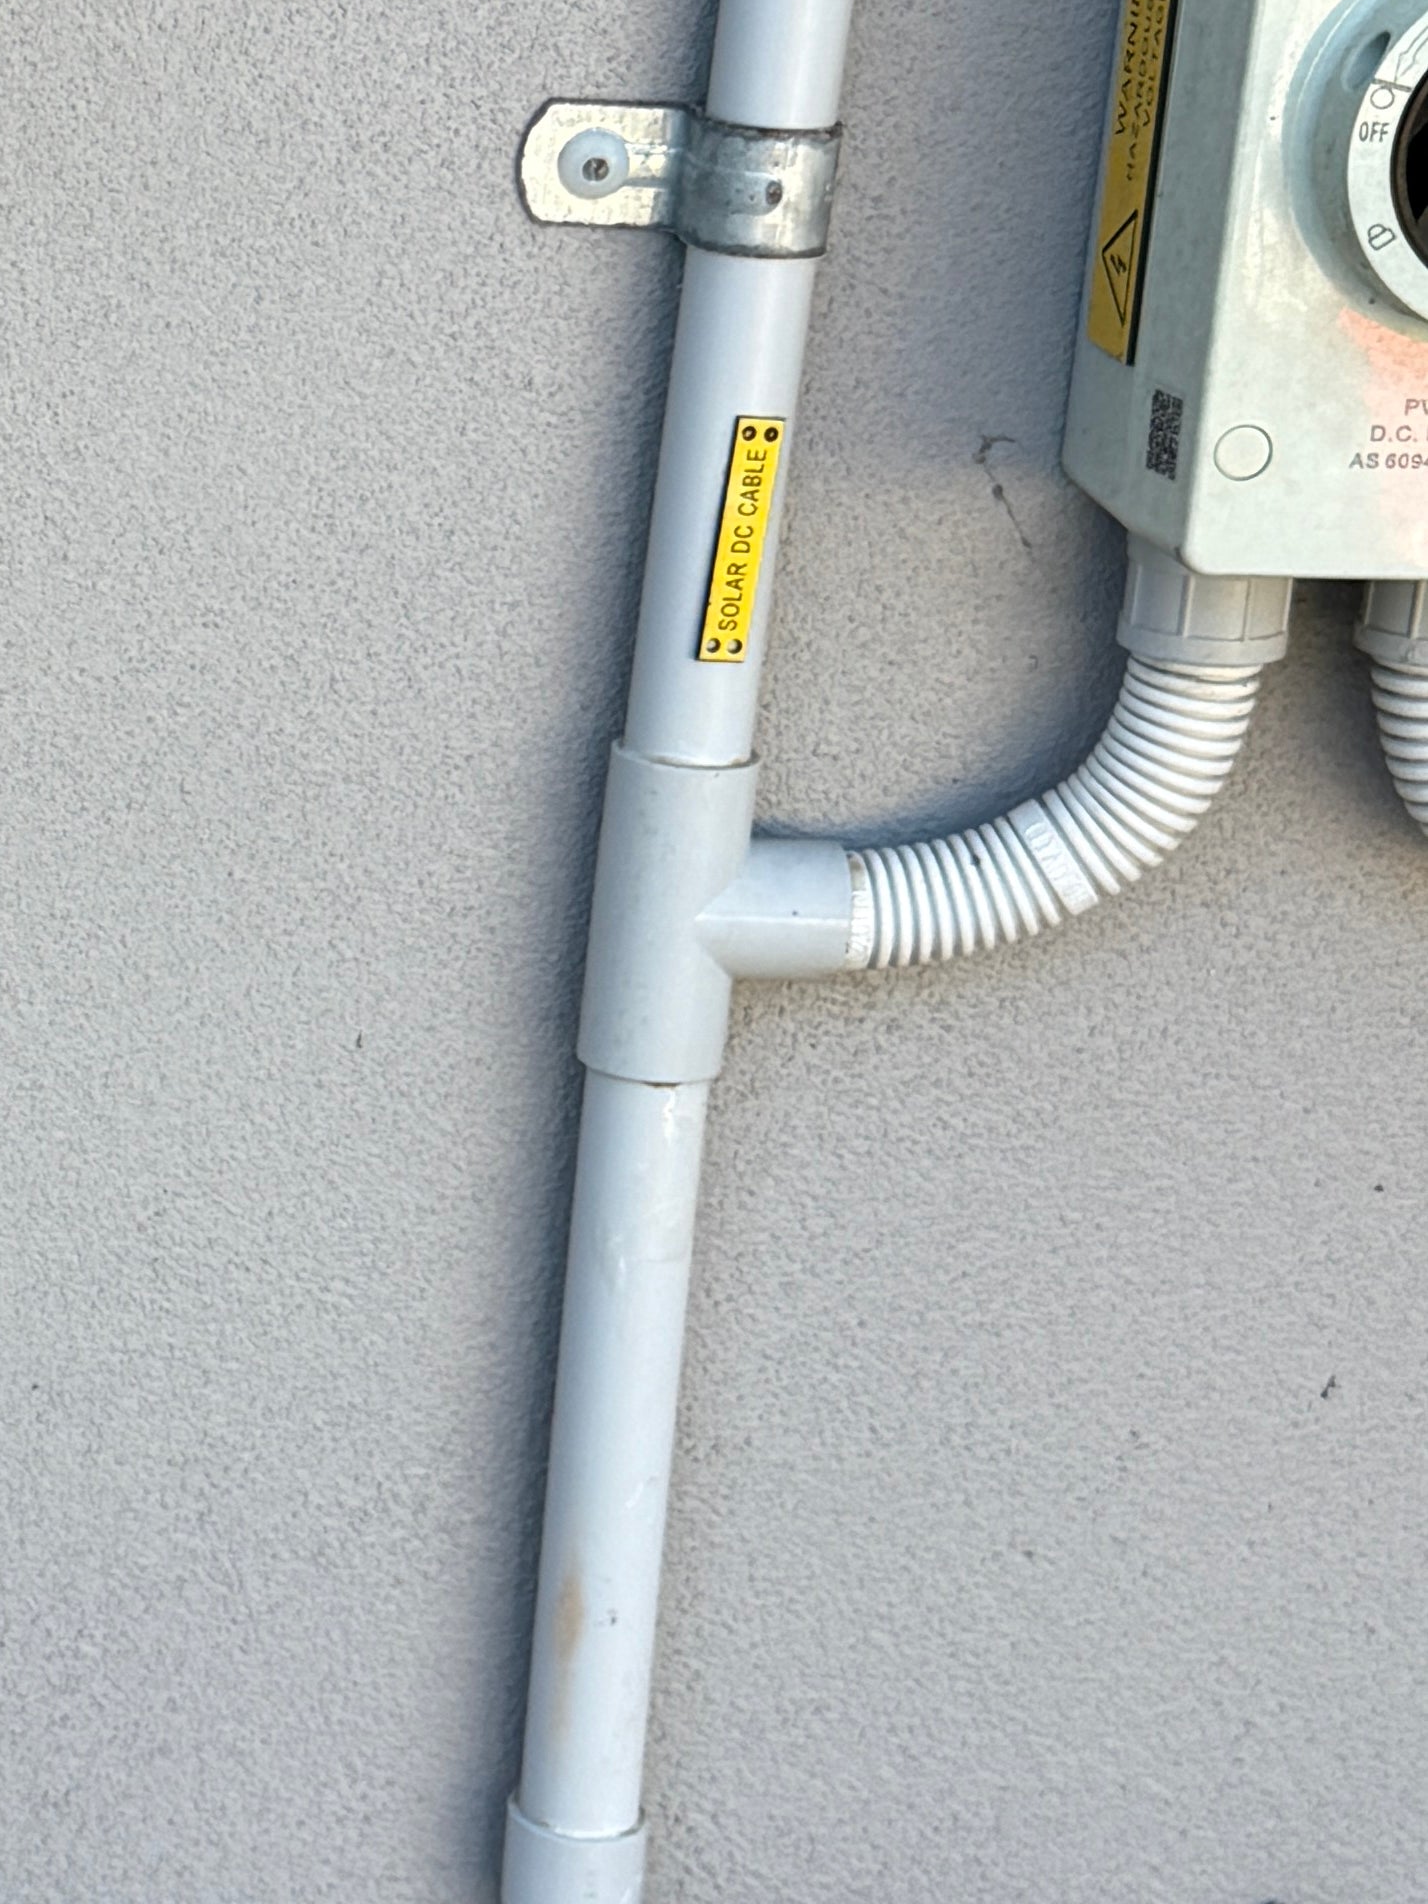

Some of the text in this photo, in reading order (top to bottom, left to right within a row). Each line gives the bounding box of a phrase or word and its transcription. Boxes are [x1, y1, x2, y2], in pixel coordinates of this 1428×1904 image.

[1358, 121, 1391, 144] OFF
[1369, 424, 1419, 443] D.C.
[1348, 452, 1380, 469] AS
[718, 448, 767, 632] SOLAR DC CABLE
